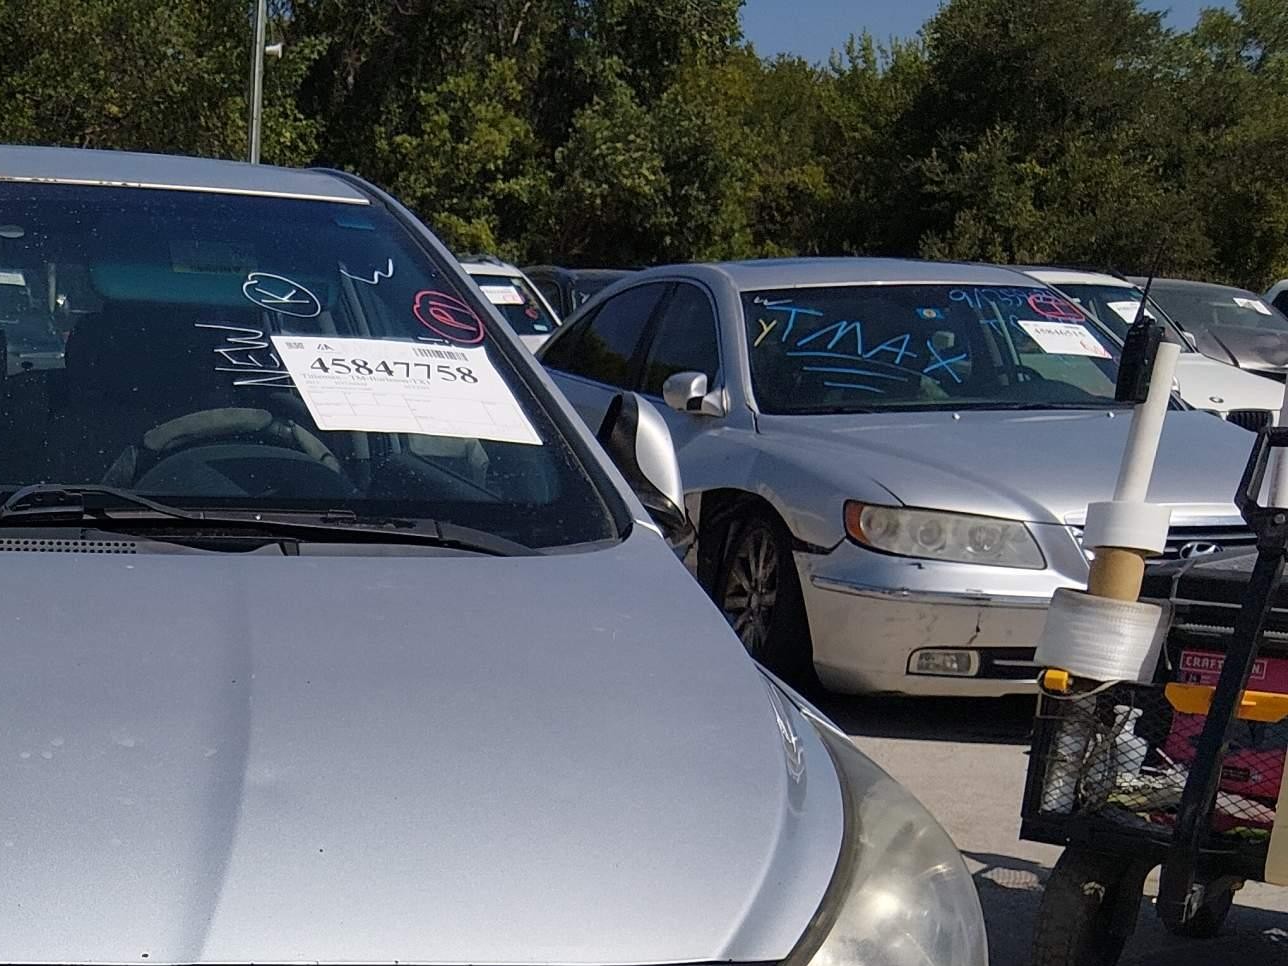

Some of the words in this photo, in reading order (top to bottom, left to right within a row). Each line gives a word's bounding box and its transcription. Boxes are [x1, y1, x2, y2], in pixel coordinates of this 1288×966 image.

[194, 322, 296, 387] NEW
[766, 305, 968, 384] TMAX
[310, 356, 479, 385] 45847758
[1185, 655, 1260, 675] CRAFTN
